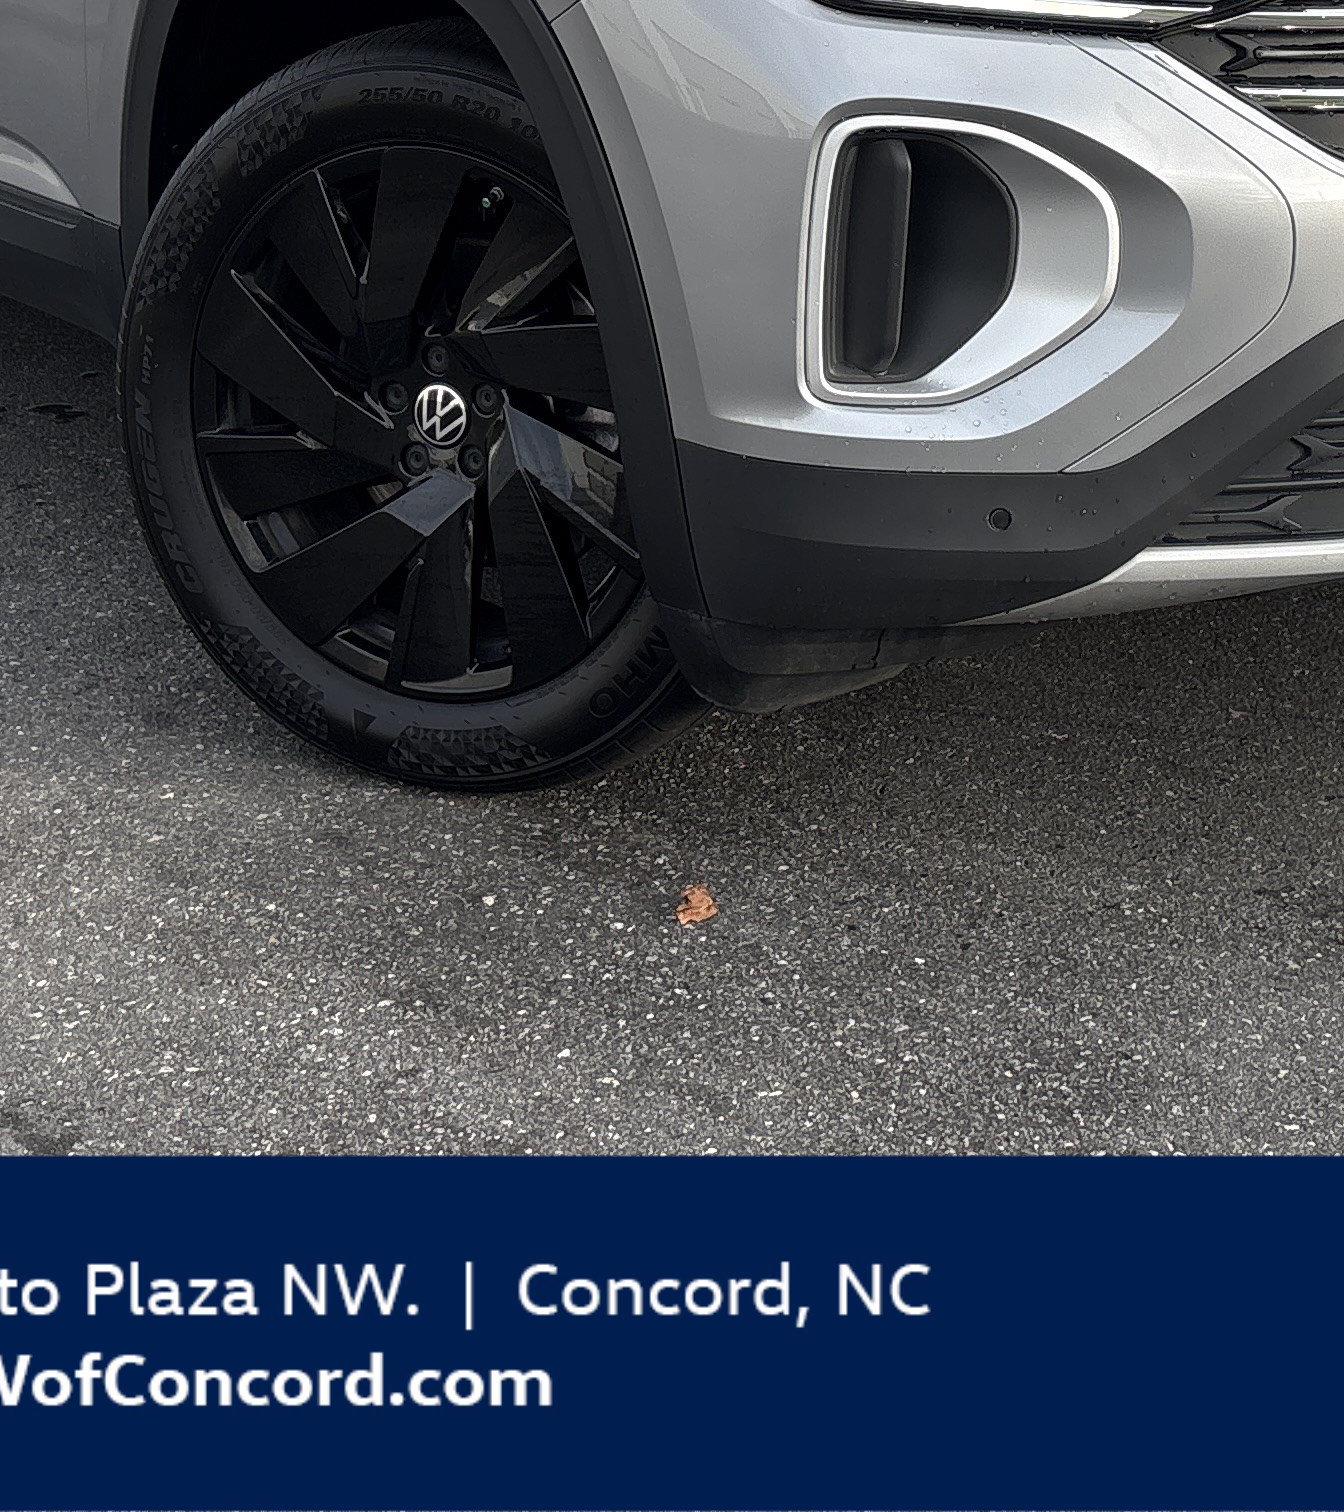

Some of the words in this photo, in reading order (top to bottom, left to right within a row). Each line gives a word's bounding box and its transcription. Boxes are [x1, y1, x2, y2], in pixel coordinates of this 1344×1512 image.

[358, 87, 444, 106] 255/50
[452, 94, 502, 123] R20
[134, 386, 204, 594] CRUGEN
[588, 623, 671, 718] MHO
